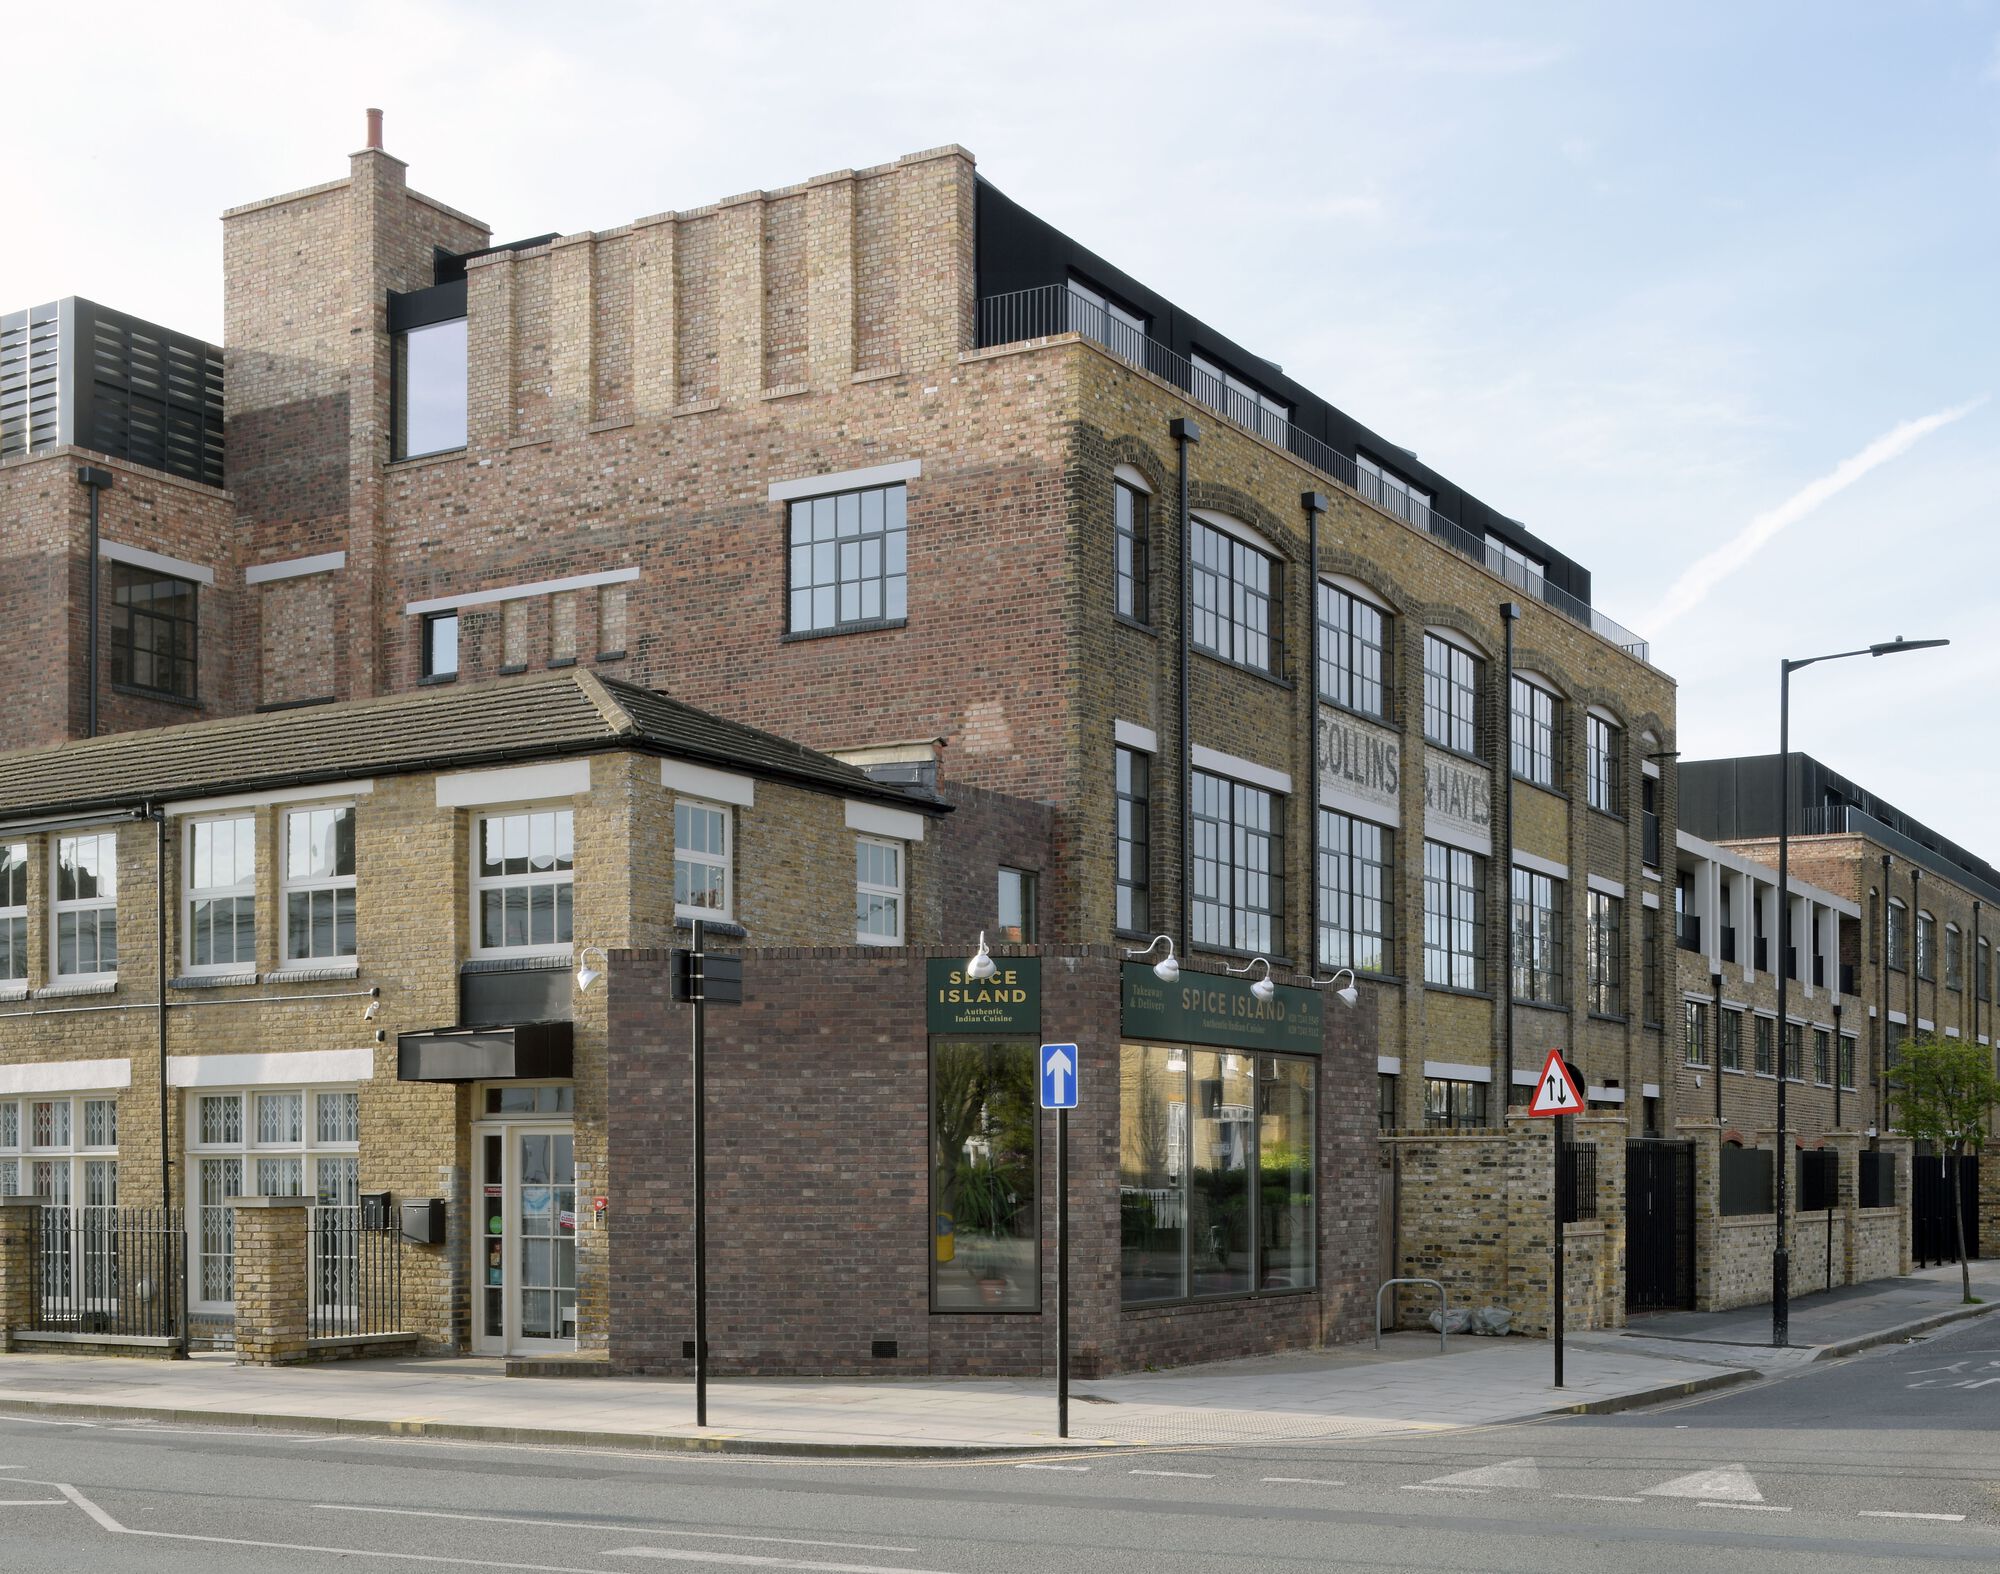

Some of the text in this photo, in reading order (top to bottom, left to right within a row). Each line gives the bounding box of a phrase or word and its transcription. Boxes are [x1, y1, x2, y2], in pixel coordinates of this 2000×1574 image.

[1319, 719, 1398, 795] COLLINS
[1438, 763, 1490, 826] HAYES
[939, 989, 1026, 1003] ISLAND
[1182, 987, 1285, 1022] SPICE ISLAND
[955, 1015, 981, 1023] Indian
